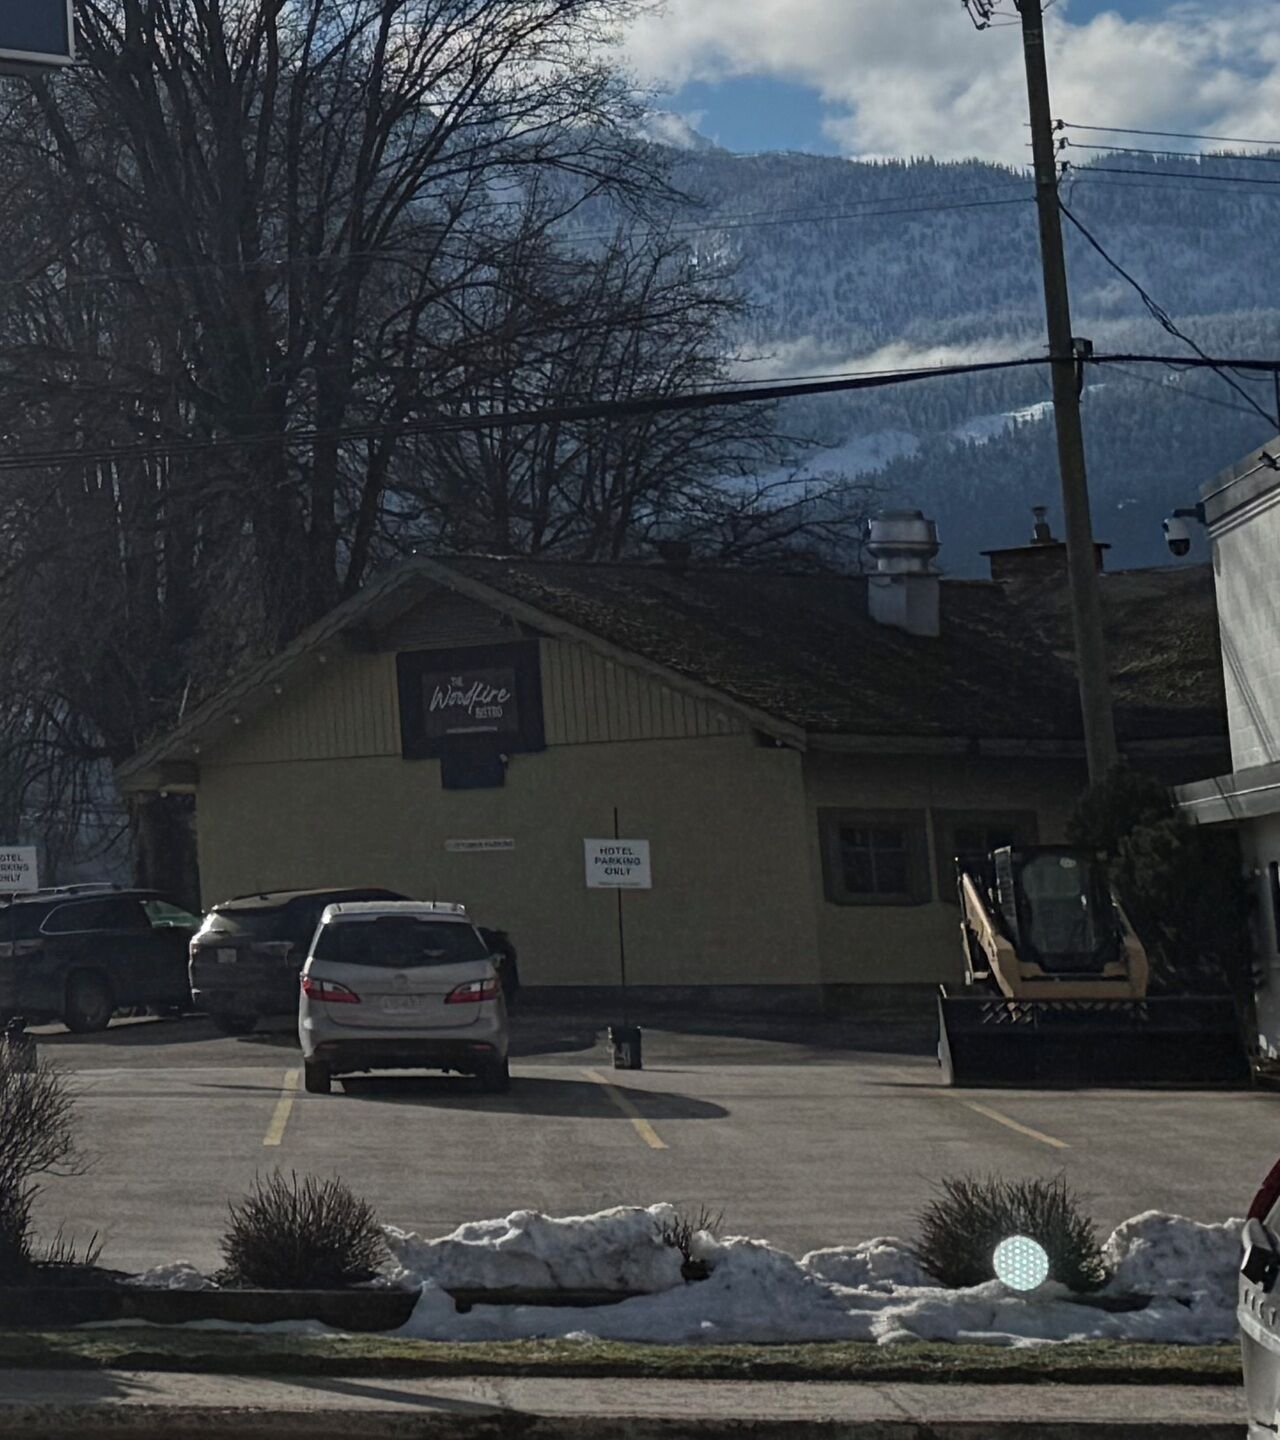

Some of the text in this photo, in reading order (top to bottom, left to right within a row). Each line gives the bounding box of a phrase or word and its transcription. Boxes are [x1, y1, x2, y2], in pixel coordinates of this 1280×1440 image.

[428, 681, 511, 715] Woodfire
[600, 847, 633, 855] HOTEL
[594, 856, 641, 866] PARKING
[604, 867, 631, 876] ONLY
